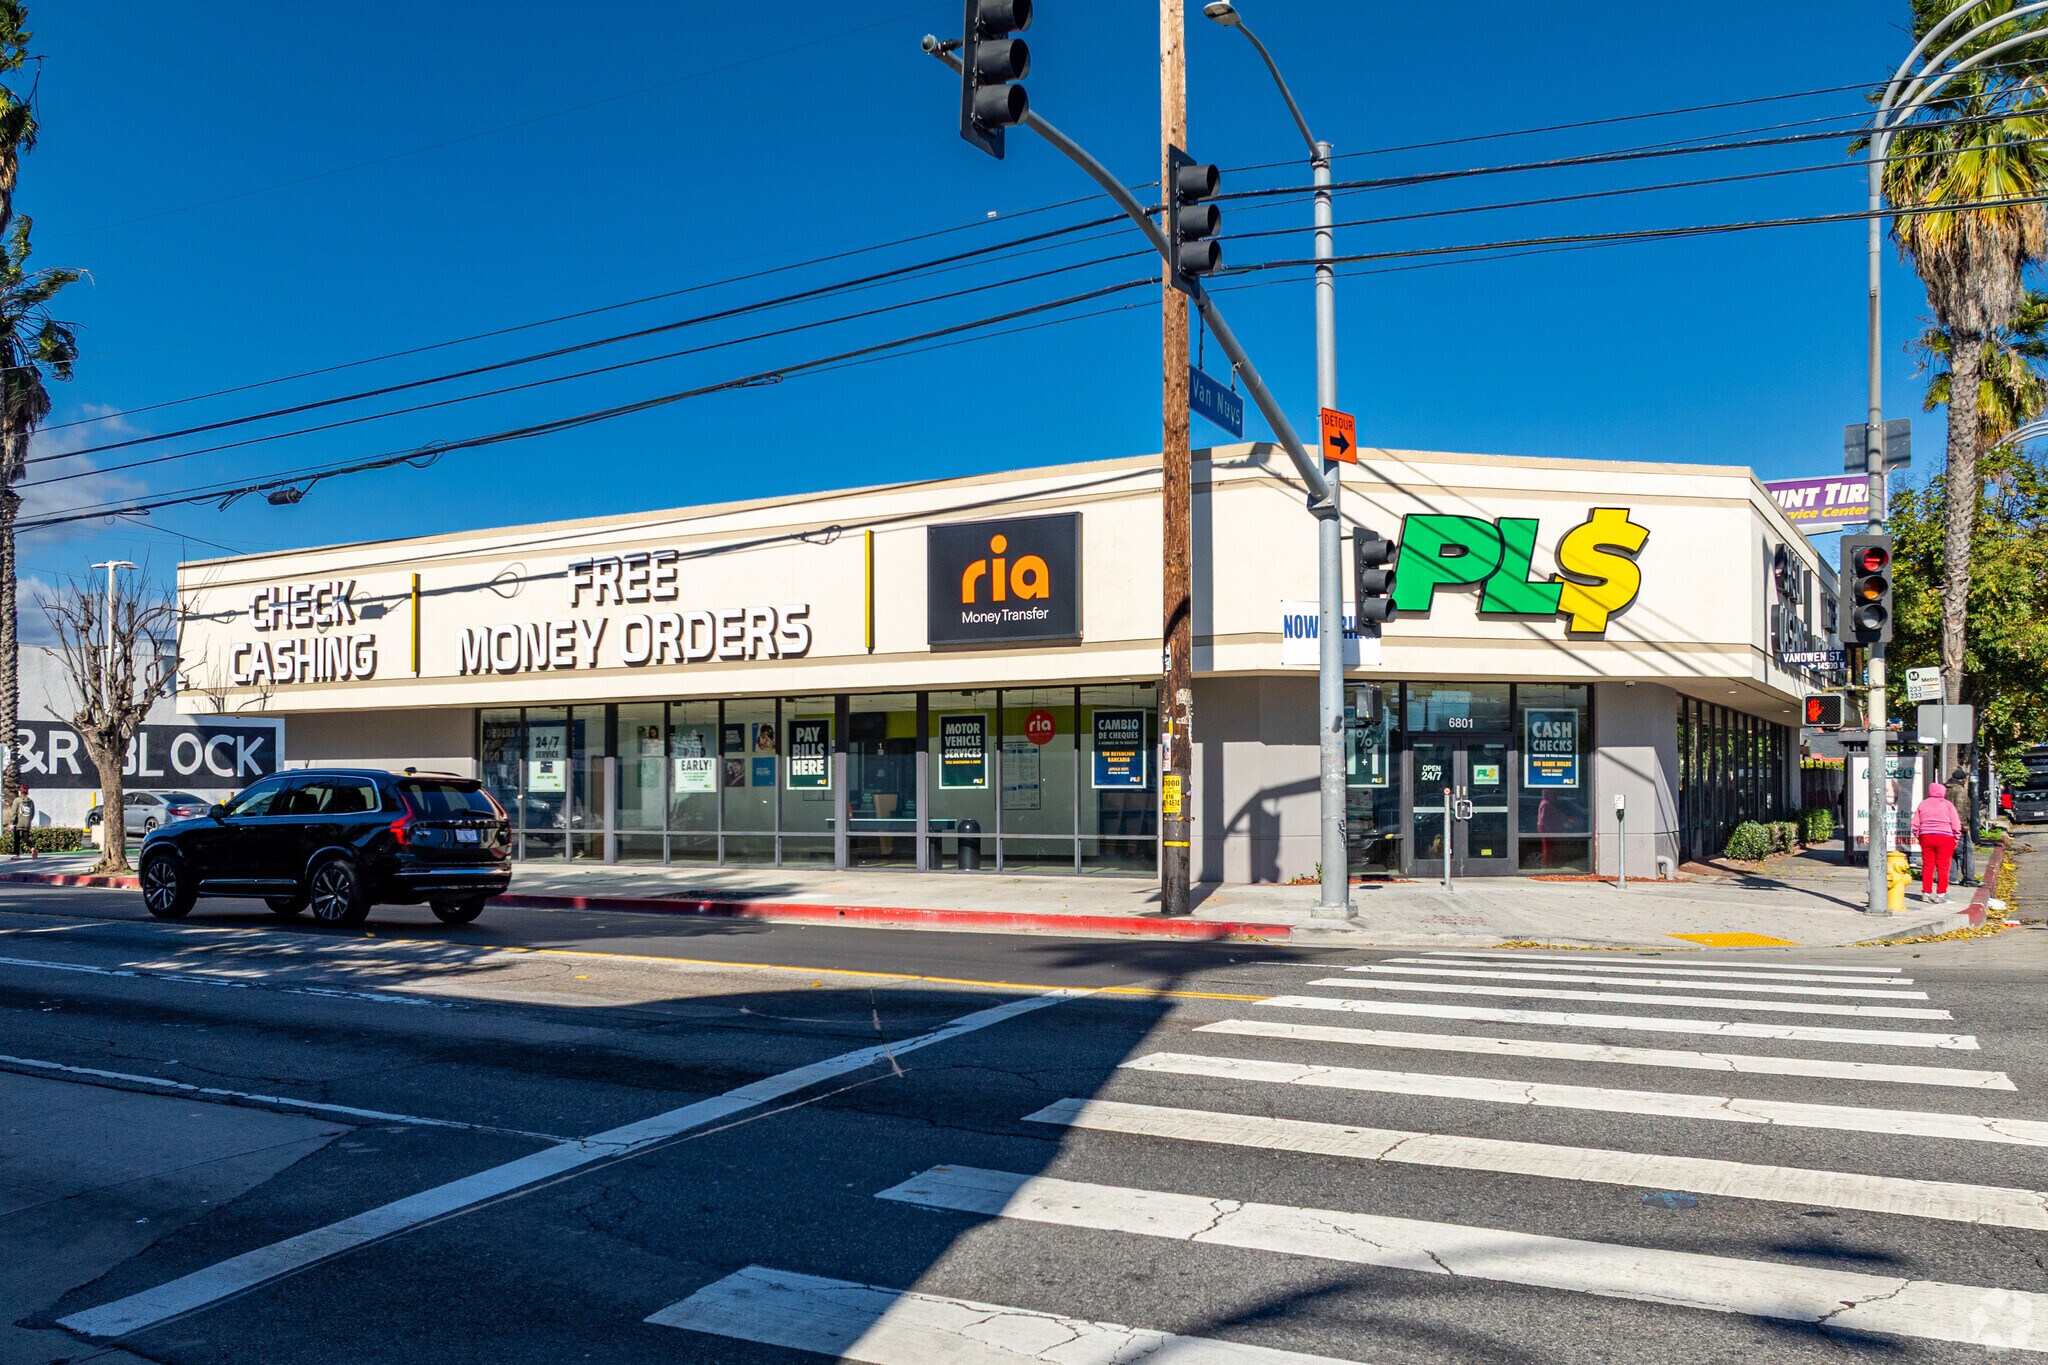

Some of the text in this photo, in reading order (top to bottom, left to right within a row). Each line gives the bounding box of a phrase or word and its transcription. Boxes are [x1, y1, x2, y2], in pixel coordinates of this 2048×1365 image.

[1192, 375, 1241, 427] Van Nuys
[1324, 413, 1353, 432] DETOUR
[961, 534, 1049, 604] ria
[1391, 507, 1650, 641] PL$
[568, 550, 679, 608] FREE
[249, 579, 356, 631] CHECK
[962, 607, 1049, 625] Money Transfer
[1283, 615, 1319, 639] NOW
[455, 604, 812, 675] MONEY ORDERS
[229, 634, 377, 686] CASHING
[1783, 652, 1827, 663] VANOWEN
[946, 723, 981, 735] MOTOR
[1029, 715, 1052, 732] ria
[1098, 719, 1139, 731] CAMBIO
[1449, 717, 1474, 729] 6801
[1532, 721, 1572, 738] CASH
[535, 735, 560, 749] 24/7
[796, 727, 820, 742] PAY
[945, 736, 981, 747] VEHICLE
[1109, 731, 1139, 740] CHEQUES
[792, 743, 825, 759] BILLS
[944, 748, 982, 759] SERVICES
[1532, 740, 1573, 752] CHECKS
[535, 750, 559, 759] SERVICE
[681, 759, 712, 771] EARLY!
[792, 759, 825, 776] HERE
[1421, 772, 1442, 781] 24/7
[1476, 767, 1496, 779] PL$
